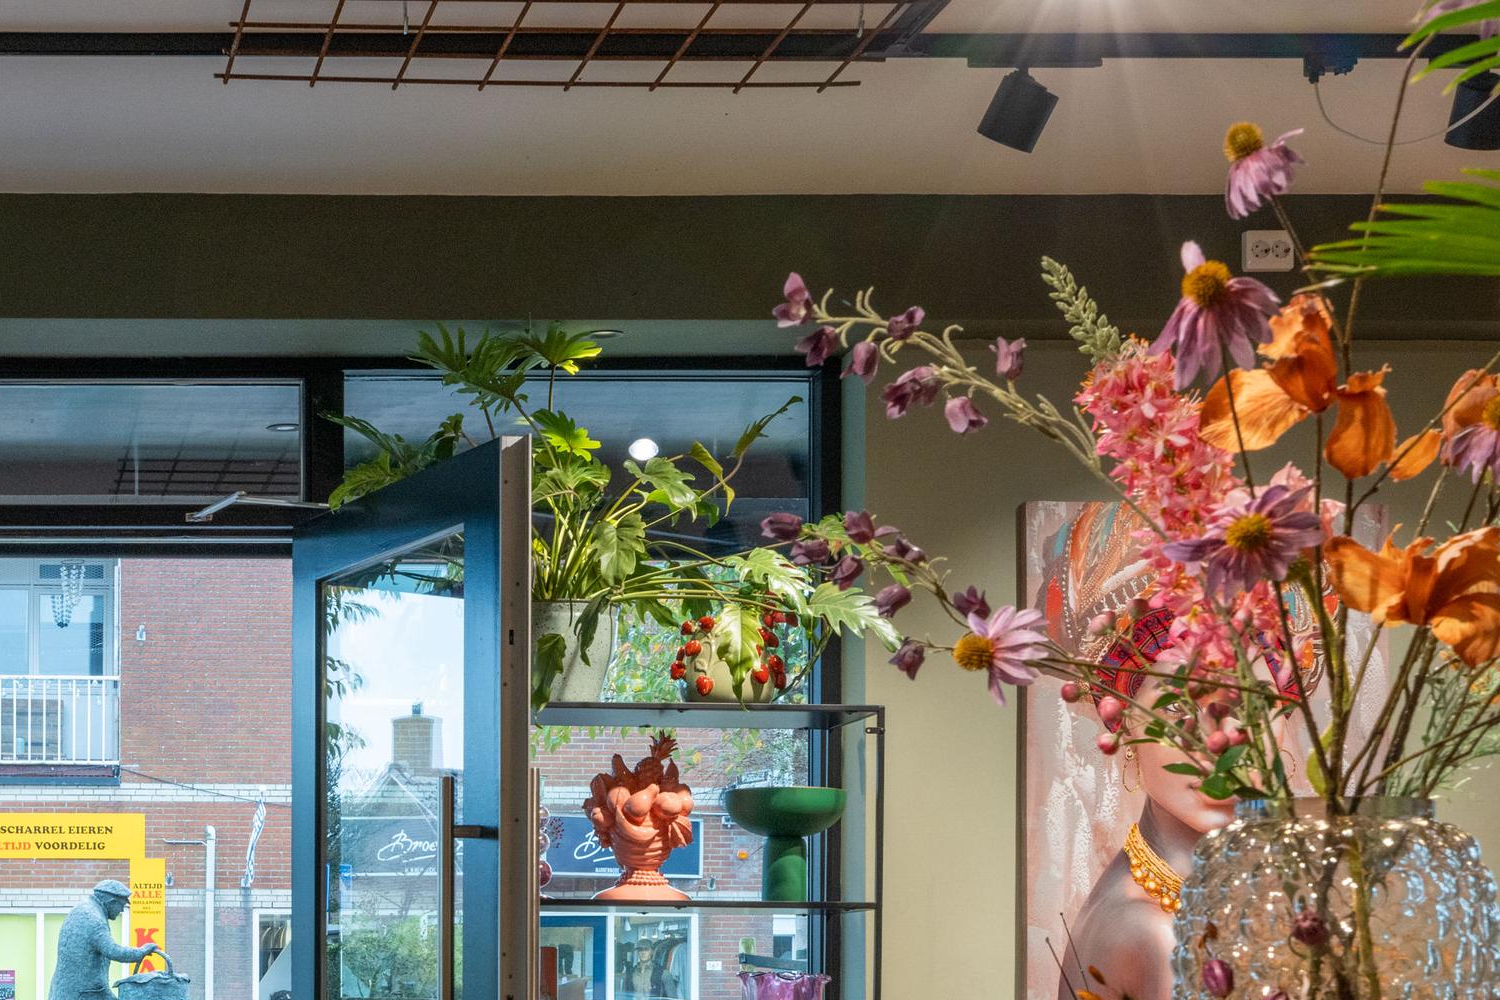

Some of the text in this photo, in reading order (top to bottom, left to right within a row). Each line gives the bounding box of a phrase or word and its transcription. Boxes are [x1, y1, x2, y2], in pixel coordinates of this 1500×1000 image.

[0, 825, 66, 834] SCHARREL
[68, 825, 114, 834] EIEREN
[35, 841, 106, 851] VOORDELIG
[133, 890, 162, 899] ALLE
